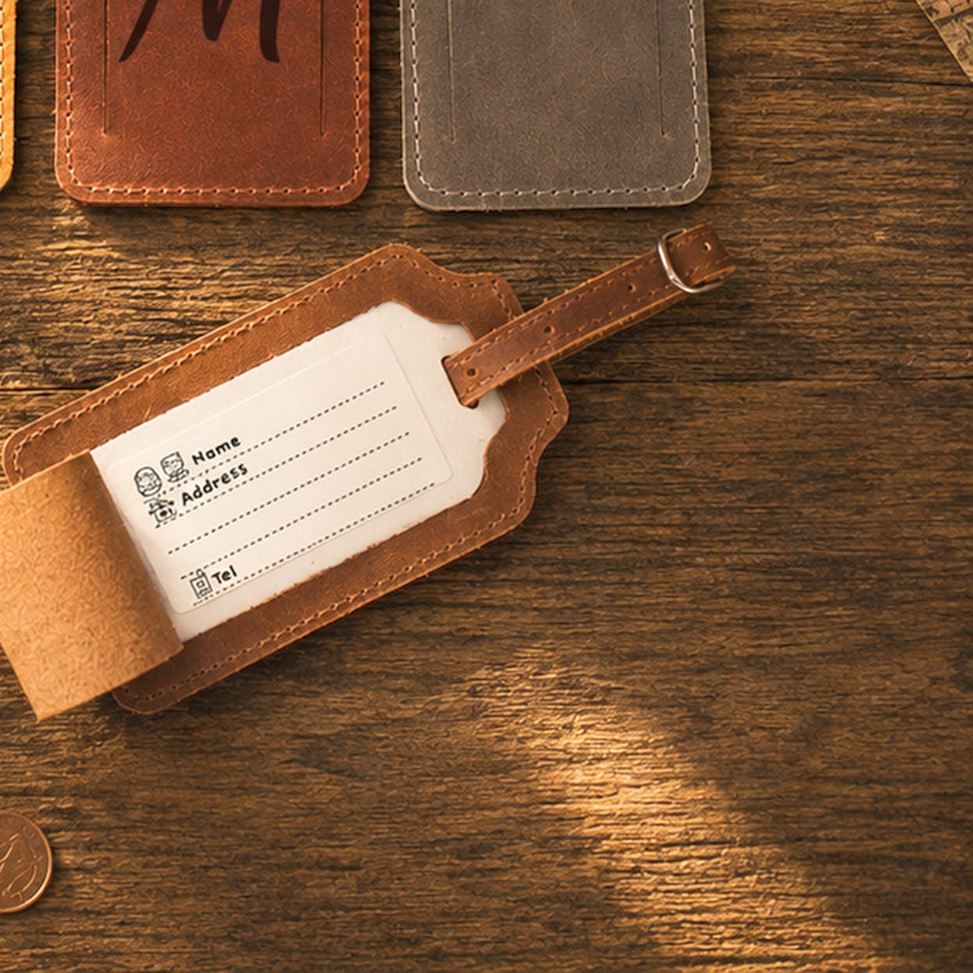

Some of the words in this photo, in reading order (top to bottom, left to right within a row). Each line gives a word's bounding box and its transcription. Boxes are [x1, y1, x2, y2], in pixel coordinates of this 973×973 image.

[191, 436, 242, 466] Name
[180, 463, 249, 507] Address
[211, 564, 239, 586] Tel
